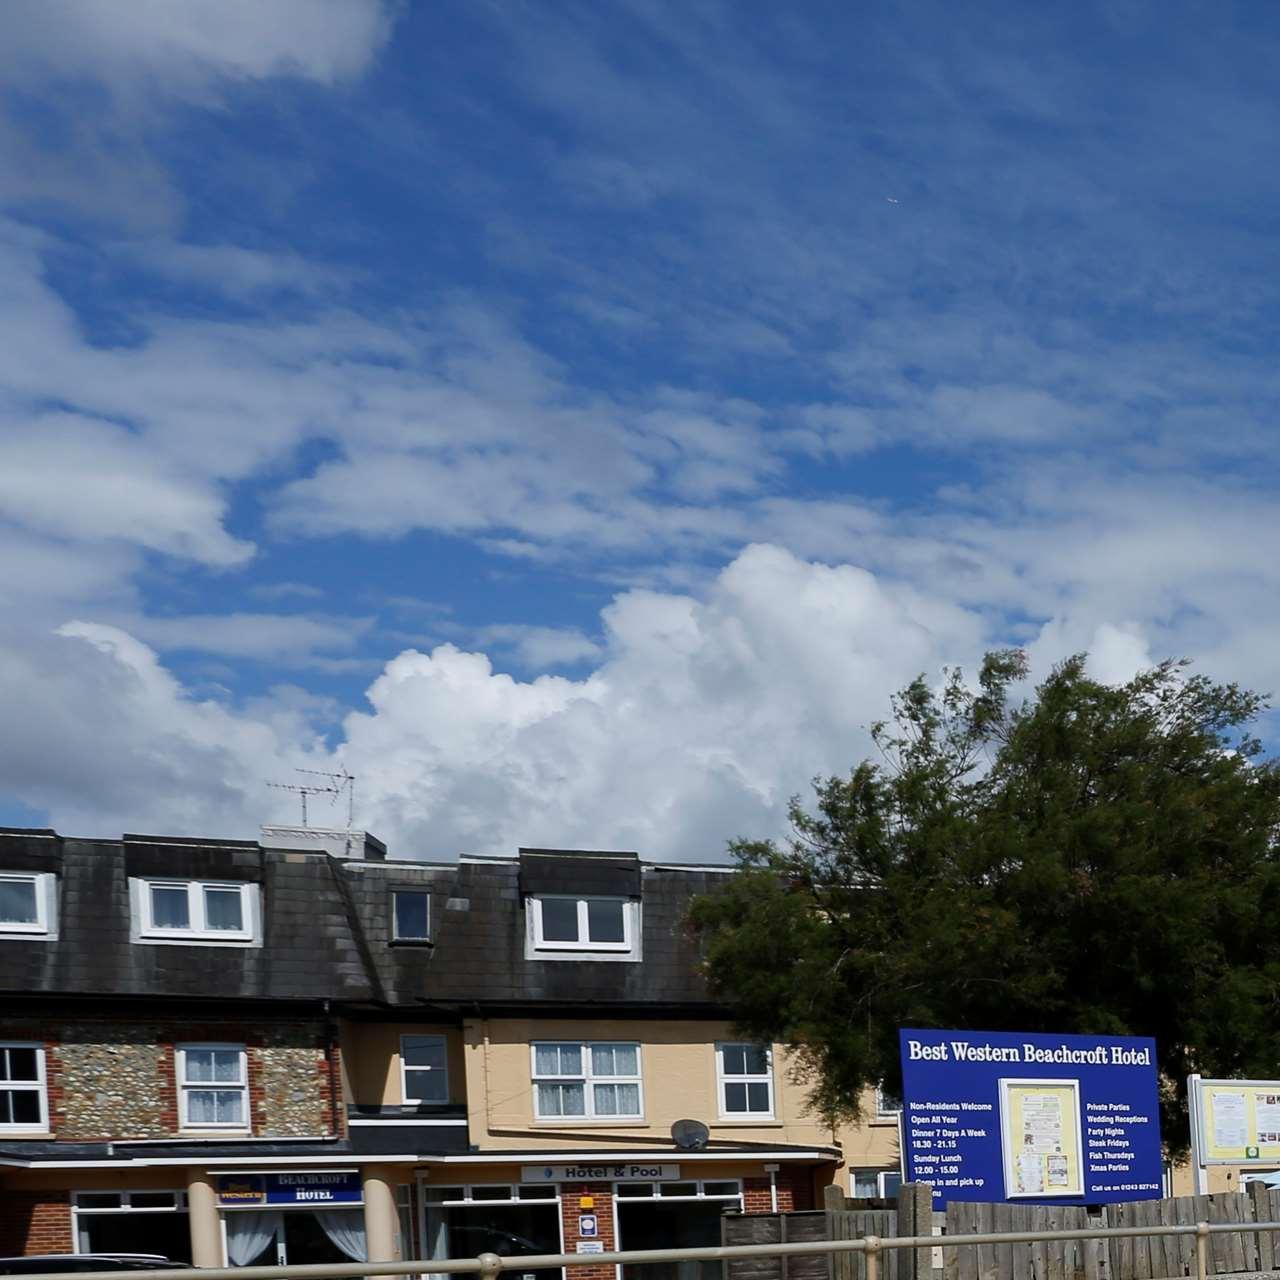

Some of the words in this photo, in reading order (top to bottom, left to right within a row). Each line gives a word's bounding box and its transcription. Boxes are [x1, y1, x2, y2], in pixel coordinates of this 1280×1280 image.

[908, 1040, 948, 1061] Best
[950, 1041, 1021, 1062] Western
[1023, 1044, 1108, 1064] Beachcroft
[1110, 1047, 1150, 1066] Hotel
[910, 1102, 960, 1110] Non-Residents
[960, 1102, 992, 1110] Welcome
[1087, 1103, 1108, 1111] Private
[1109, 1103, 1130, 1111] Parties
[911, 1115, 930, 1125] Open
[931, 1115, 941, 1123] All
[941, 1115, 958, 1123] Year
[1087, 1115, 1114, 1124] Wedding
[1115, 1115, 1148, 1124] Receptions
[911, 1129, 935, 1137] Dinner
[936, 1129, 941, 1137] 7
[942, 1129, 959, 1139] Days
[960, 1129, 966, 1137] A
[966, 1129, 987, 1137] Week
[1088, 1128, 1104, 1137] Party
[1104, 1128, 1125, 1137] Nights
[912, 1140, 932, 1148] 18.30
[937, 1140, 957, 1148] 21.15
[1088, 1139, 1106, 1147] Steak
[1107, 1139, 1130, 1148] Fridays
[913, 1154, 940, 1164] Sunday
[940, 1154, 962, 1162] Lunch
[1089, 1151, 1103, 1159] Fish
[1103, 1151, 1135, 1160] Thursdays
[565, 1167, 607, 1178] Hotel
[613, 1166, 625, 1177] &
[630, 1165, 663, 1177] Pool
[914, 1166, 934, 1174] 12.00
[940, 1165, 959, 1174] 15.00
[1090, 1164, 1107, 1172] Xmas
[1108, 1163, 1129, 1171] Parties
[936, 1178, 944, 1186] in
[945, 1178, 958, 1186] and
[959, 1178, 974, 1187] pick
[974, 1179, 984, 1187] up
[1091, 1184, 1104, 1192] Call
[296, 1187, 334, 1200] HOTEL
